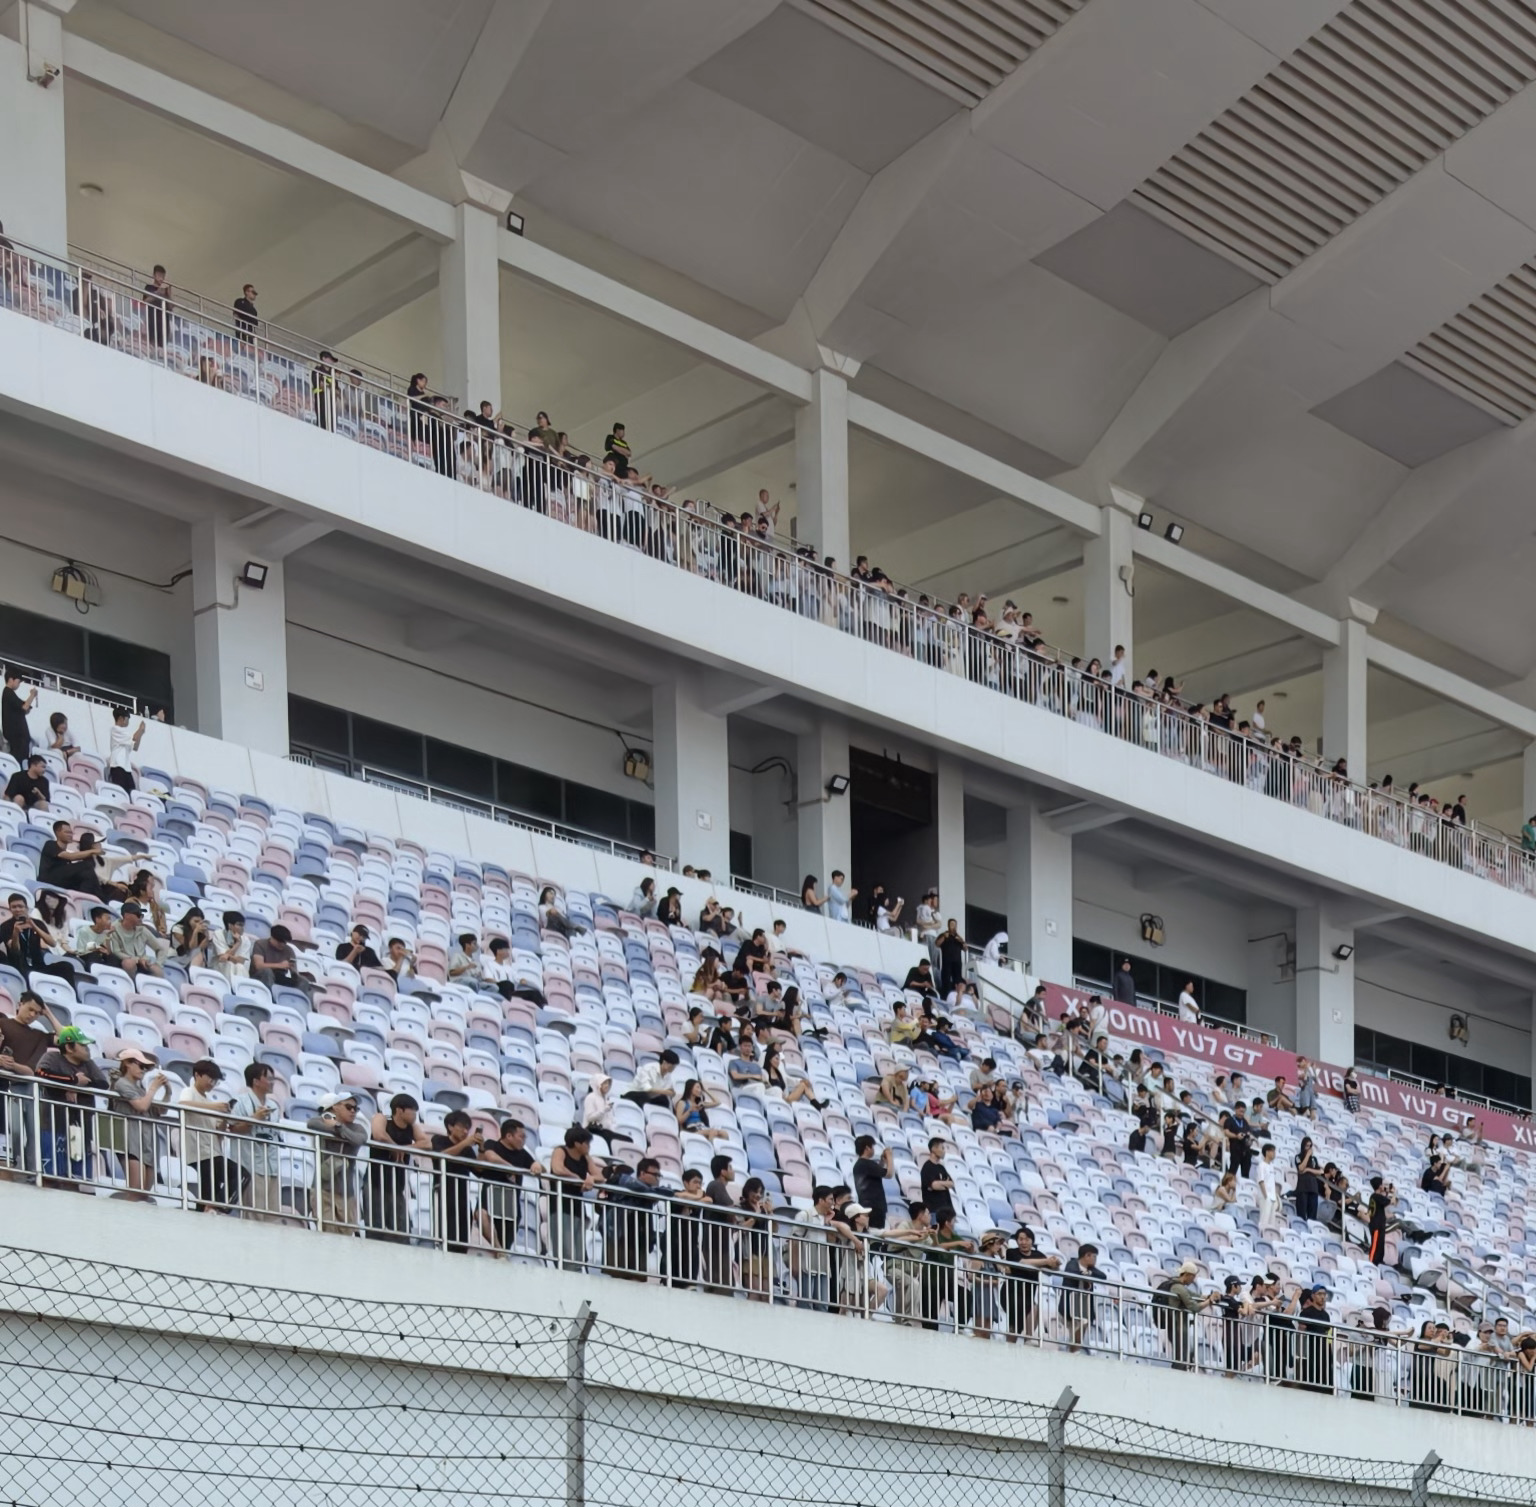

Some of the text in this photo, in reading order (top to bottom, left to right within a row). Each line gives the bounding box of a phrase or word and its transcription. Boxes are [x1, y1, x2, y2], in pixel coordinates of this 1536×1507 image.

[1172, 1026, 1218, 1056] YU7
[1223, 1043, 1263, 1066] GT
[1399, 1091, 1437, 1119] YU7
[1442, 1106, 1476, 1127] GT
